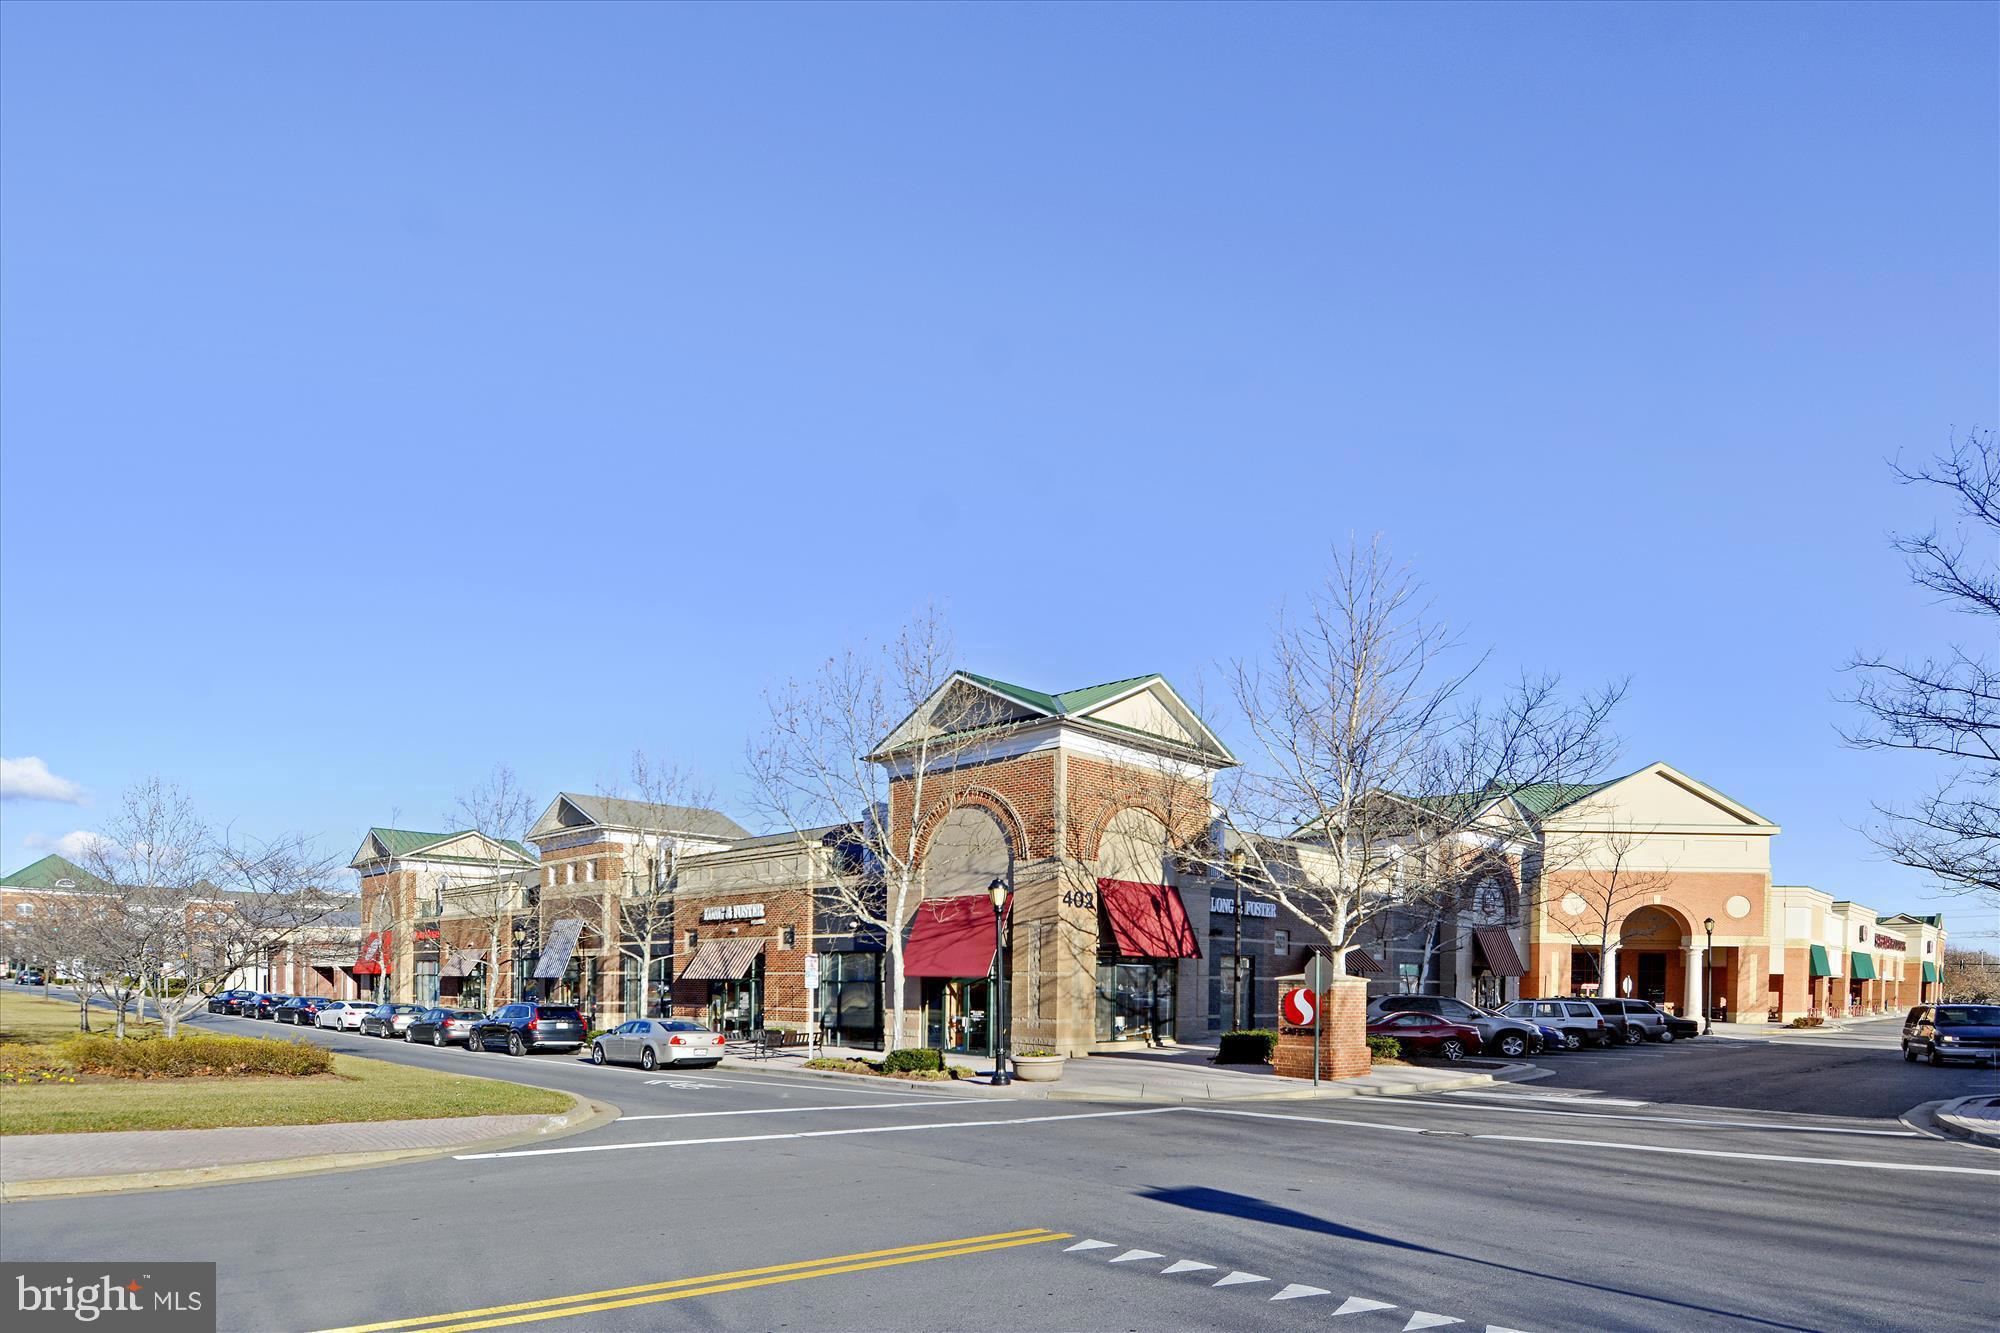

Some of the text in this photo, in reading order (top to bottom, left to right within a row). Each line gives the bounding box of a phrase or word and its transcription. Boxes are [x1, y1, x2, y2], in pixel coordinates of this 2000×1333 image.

[1063, 890, 1093, 908] 402
[1210, 897, 1234, 914] LONG
[1244, 901, 1277, 918] FOSTER
[1279, 1026, 1324, 1037] SAFEWY
